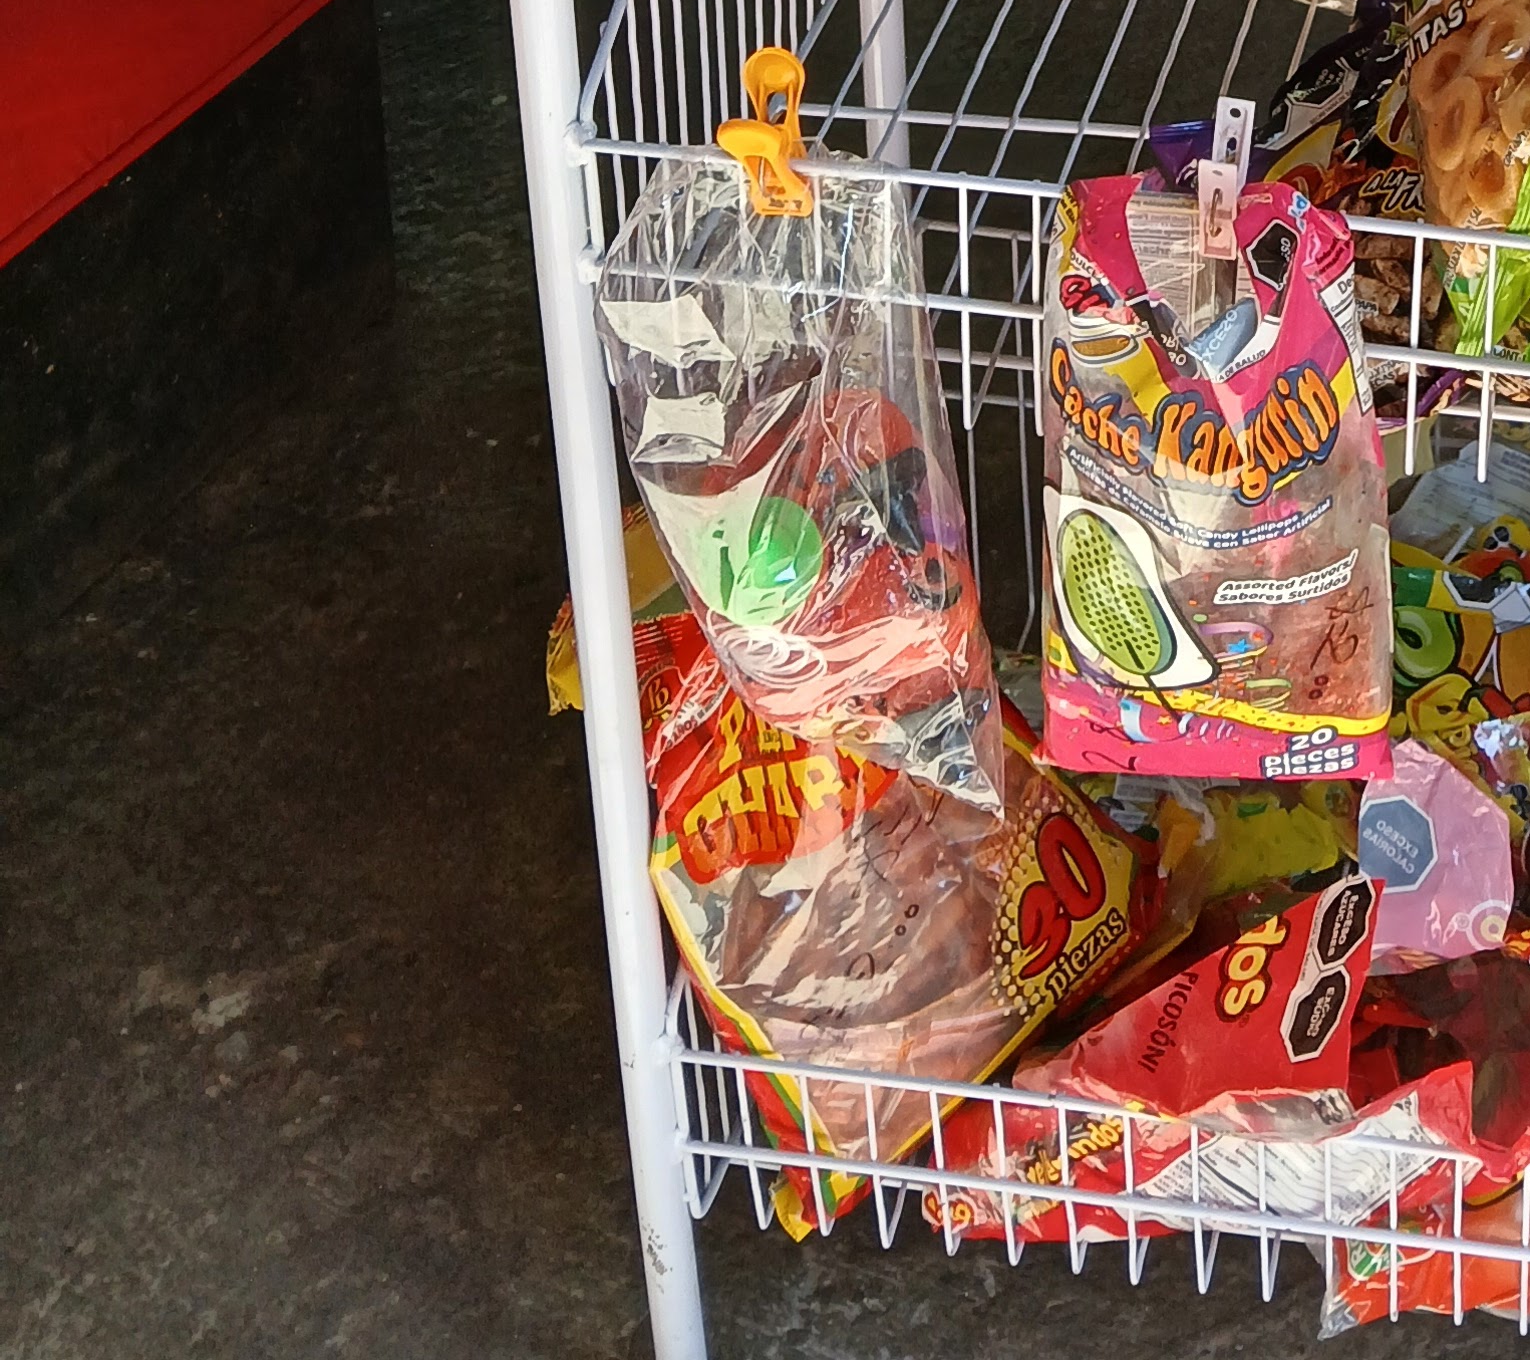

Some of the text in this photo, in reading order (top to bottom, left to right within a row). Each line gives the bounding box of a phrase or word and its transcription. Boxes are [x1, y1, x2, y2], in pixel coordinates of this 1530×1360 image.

[1051, 340, 1142, 469] Cache
[1157, 362, 1339, 508] Kangurin
[1069, 447, 1121, 489] Artificially
[1122, 487, 1168, 521] Flavored
[1197, 528, 1239, 541] Candy
[1242, 513, 1300, 539] Lollipops
[1242, 528, 1281, 546] Sabor
[1283, 499, 1332, 537] Artificial
[1218, 574, 1349, 603] Sabores Surtidos
[1223, 579, 1296, 592] Assorted
[1265, 742, 1355, 769] pieces
[1291, 726, 1332, 750] 20
[1266, 756, 1355, 779] piezas
[1017, 814, 1107, 979] 30
[1049, 908, 1128, 1002] piezas
